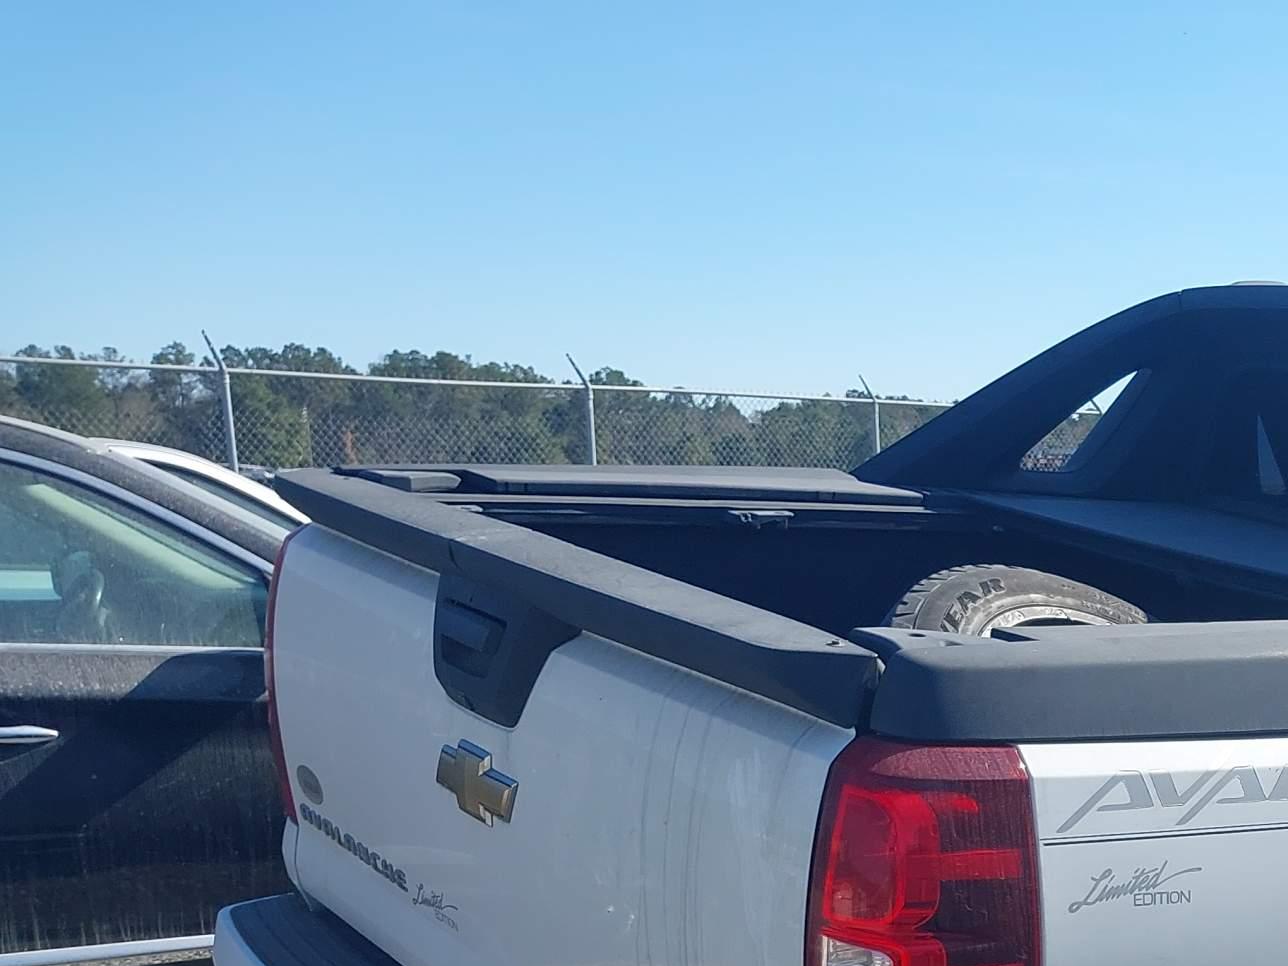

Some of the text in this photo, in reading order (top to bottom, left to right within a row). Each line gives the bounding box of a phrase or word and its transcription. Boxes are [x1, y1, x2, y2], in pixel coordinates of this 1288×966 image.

[299, 803, 408, 892] AVALANCHE
[412, 883, 459, 911] Limited
[1068, 859, 1203, 913] Limited
[1133, 889, 1191, 907] EDITION
